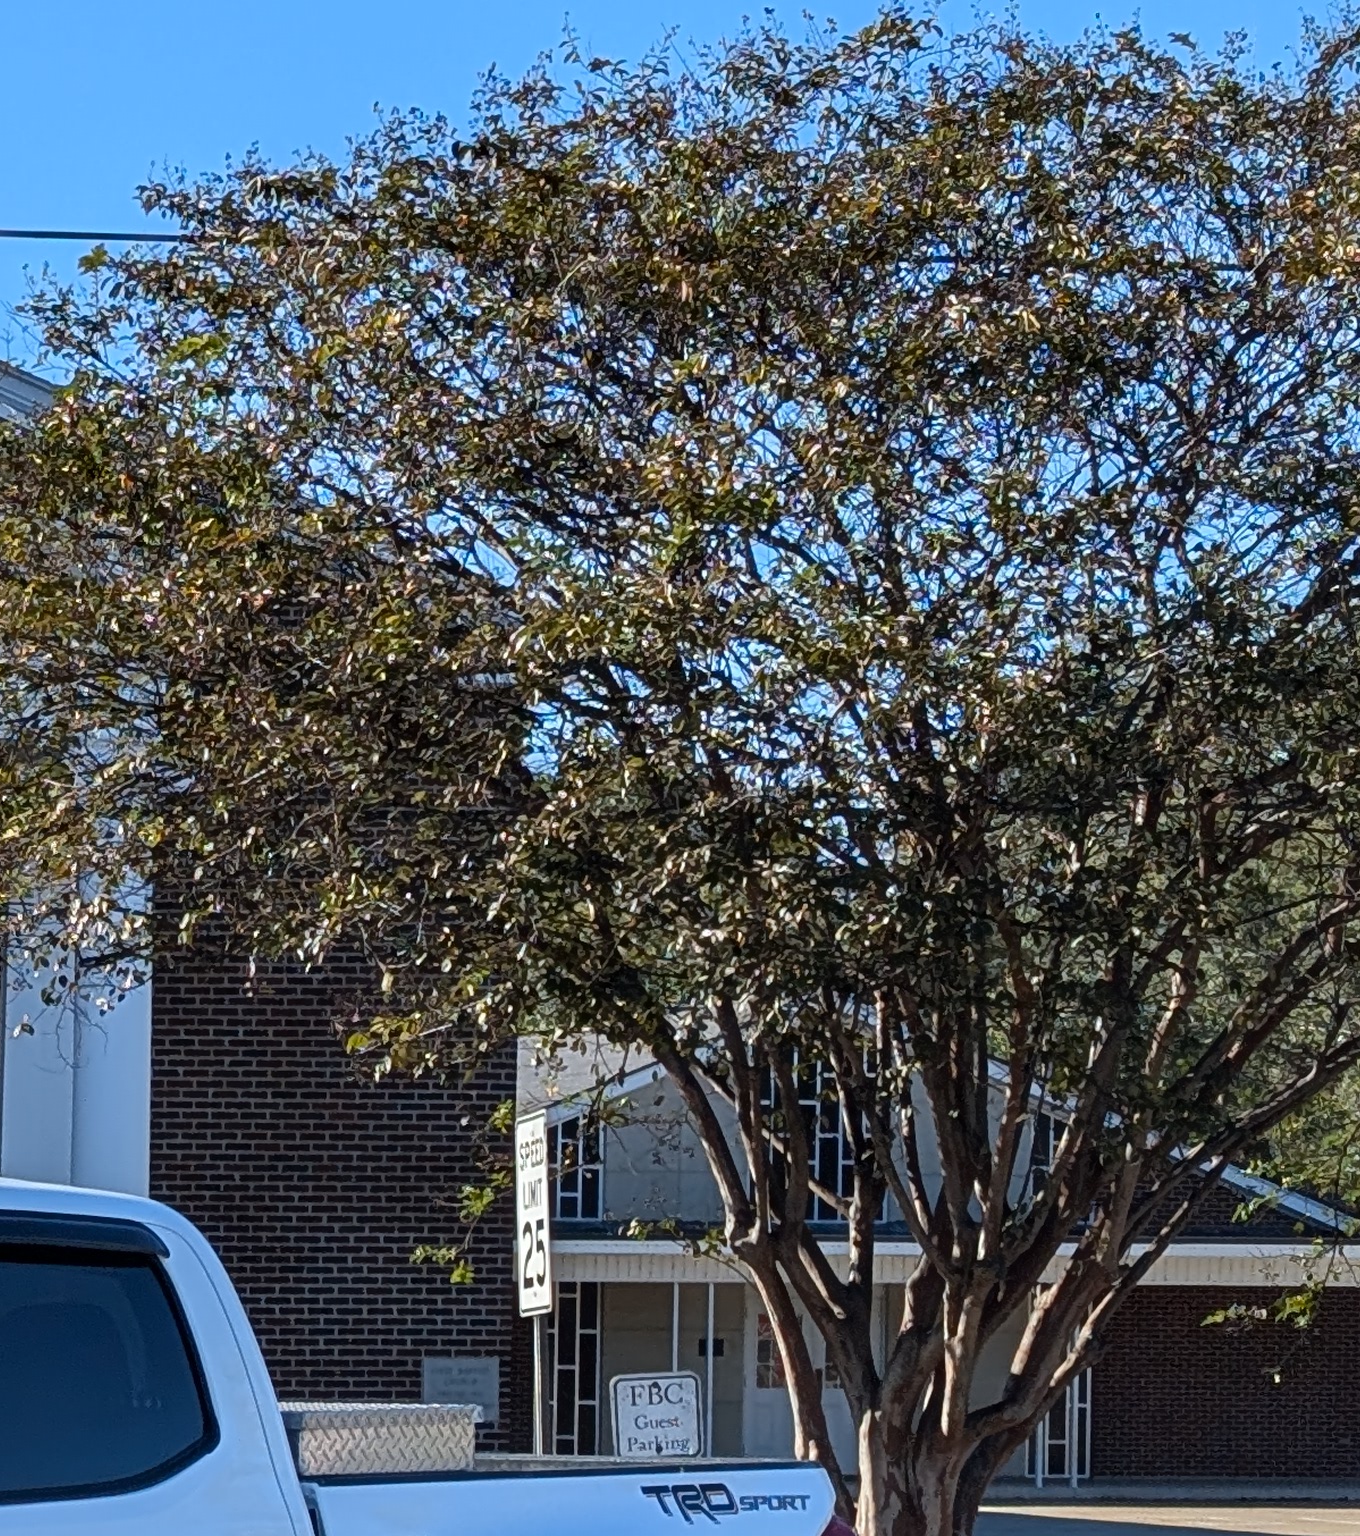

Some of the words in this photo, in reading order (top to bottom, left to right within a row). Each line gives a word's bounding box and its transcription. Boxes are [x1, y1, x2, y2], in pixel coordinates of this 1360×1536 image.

[520, 1136, 544, 1171] SPEED
[523, 1178, 543, 1210] LIMIT
[523, 1218, 547, 1289] 25
[630, 1382, 684, 1407] FBC
[634, 1415, 680, 1430] Guest
[627, 1436, 690, 1453] Parking
[640, 1483, 739, 1525] TRD
[740, 1495, 810, 1512] SPORT
